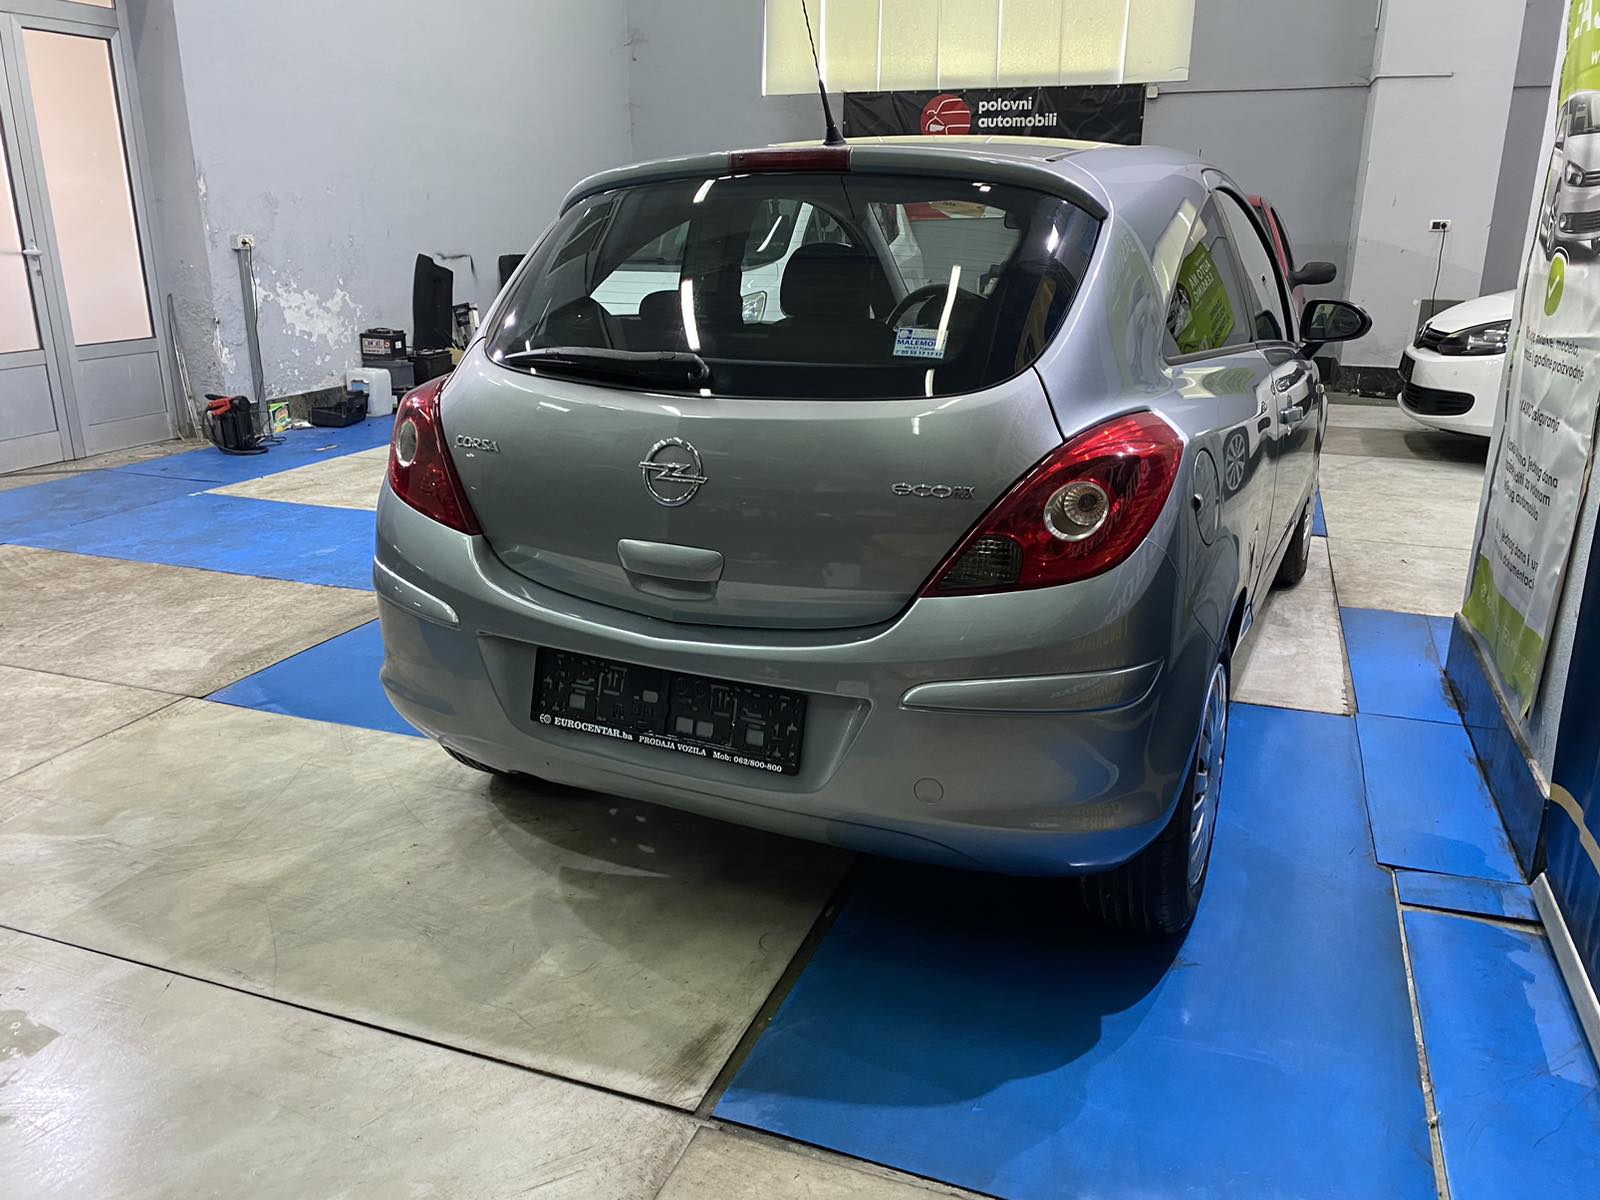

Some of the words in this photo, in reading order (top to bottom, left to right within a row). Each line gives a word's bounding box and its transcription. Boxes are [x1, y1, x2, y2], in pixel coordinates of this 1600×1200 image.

[978, 97, 1033, 113] polovni
[978, 112, 1057, 128] automobili
[455, 434, 499, 452] CORSA
[554, 716, 633, 741] EUROCENTAR.ba
[638, 735, 676, 750] PRODAJA
[677, 743, 707, 757] VOZILA
[712, 750, 732, 763] Mob:
[733, 755, 782, 773] 062/800-800
